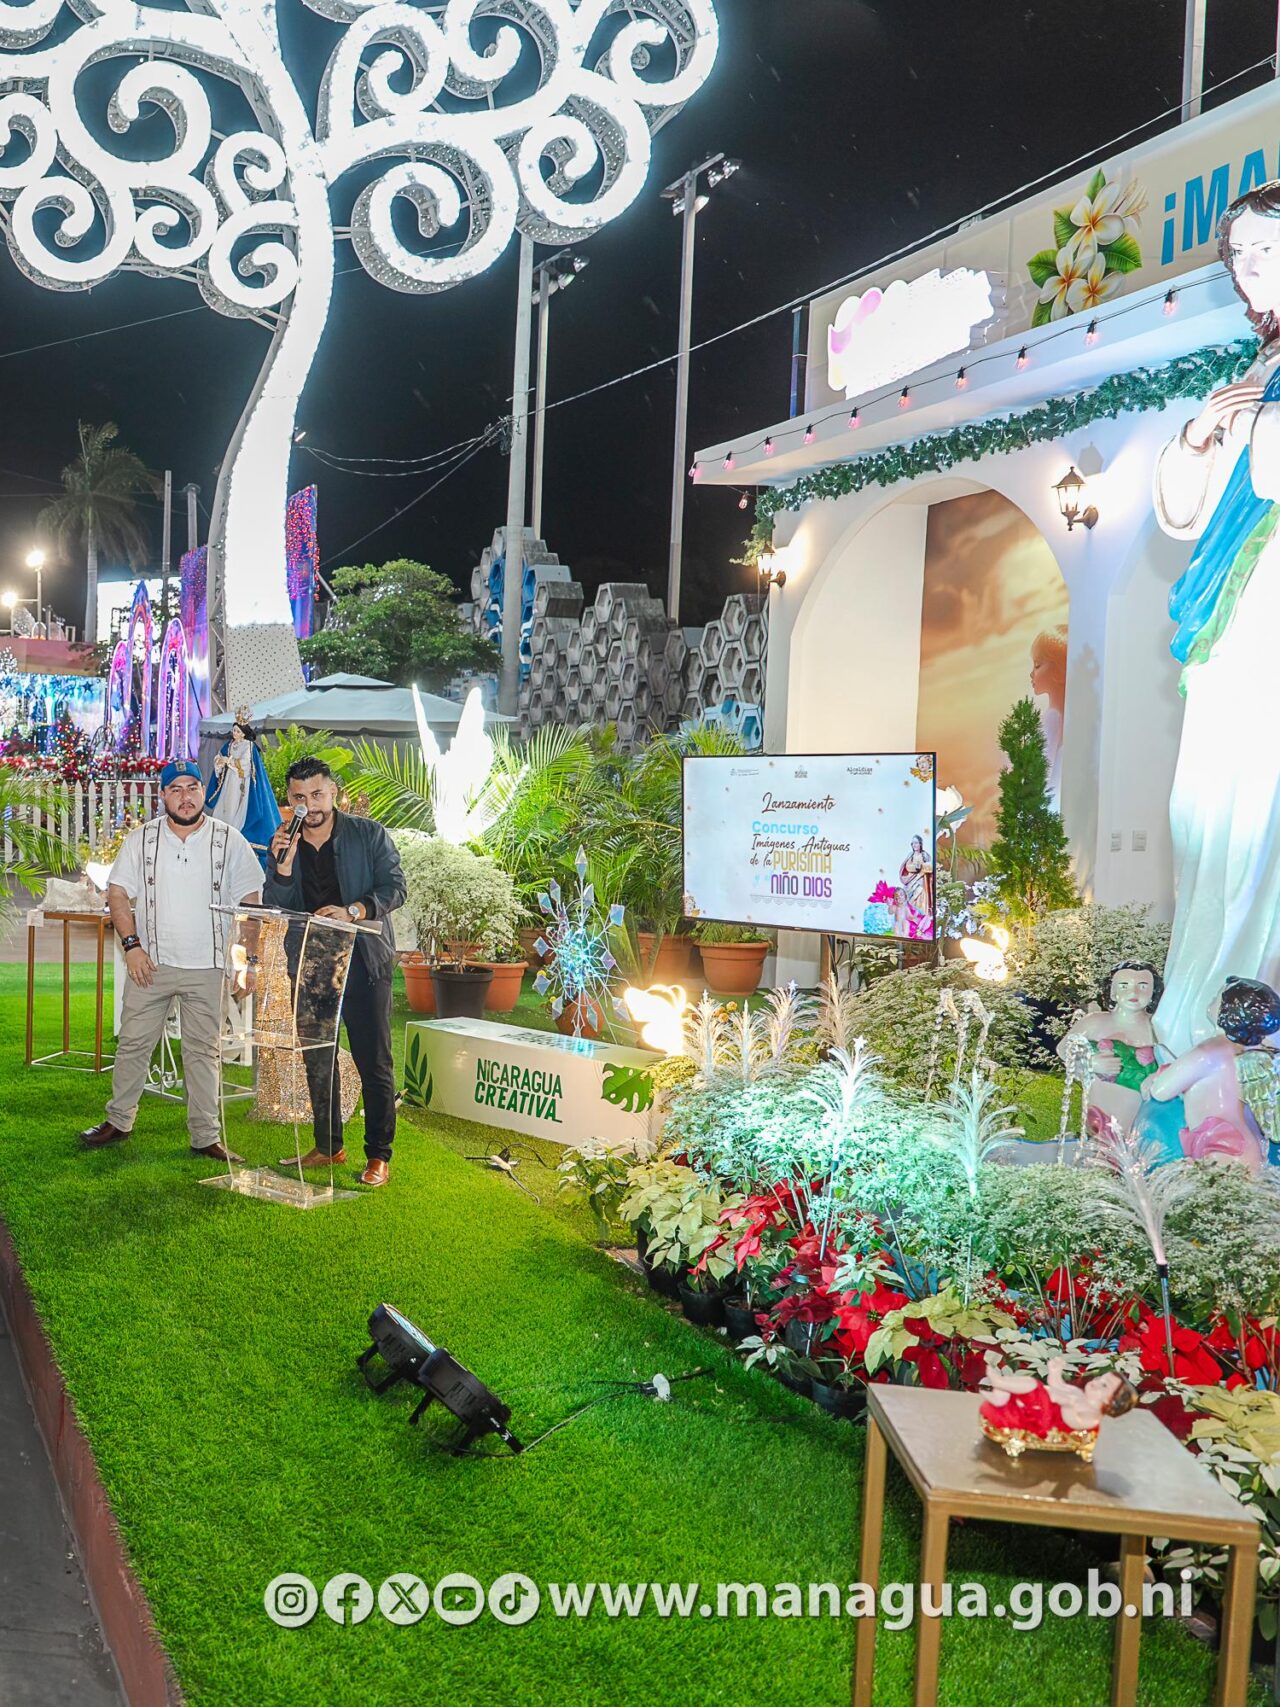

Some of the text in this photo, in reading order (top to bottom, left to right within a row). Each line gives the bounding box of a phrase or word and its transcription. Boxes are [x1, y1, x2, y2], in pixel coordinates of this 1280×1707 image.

[1161, 141, 1280, 265] ¡MA
[761, 791, 836, 813] Lanzamiento
[752, 821, 819, 835] Concurso
[751, 833, 850, 856] Imágenes Antiguas
[750, 852, 759, 865] de
[763, 852, 772, 867] la
[771, 872, 799, 896] NIÑO
[803, 876, 832, 898] DIOS
[476, 1058, 562, 1098] NICARAGUA
[474, 1082, 563, 1123] CREATIVA
